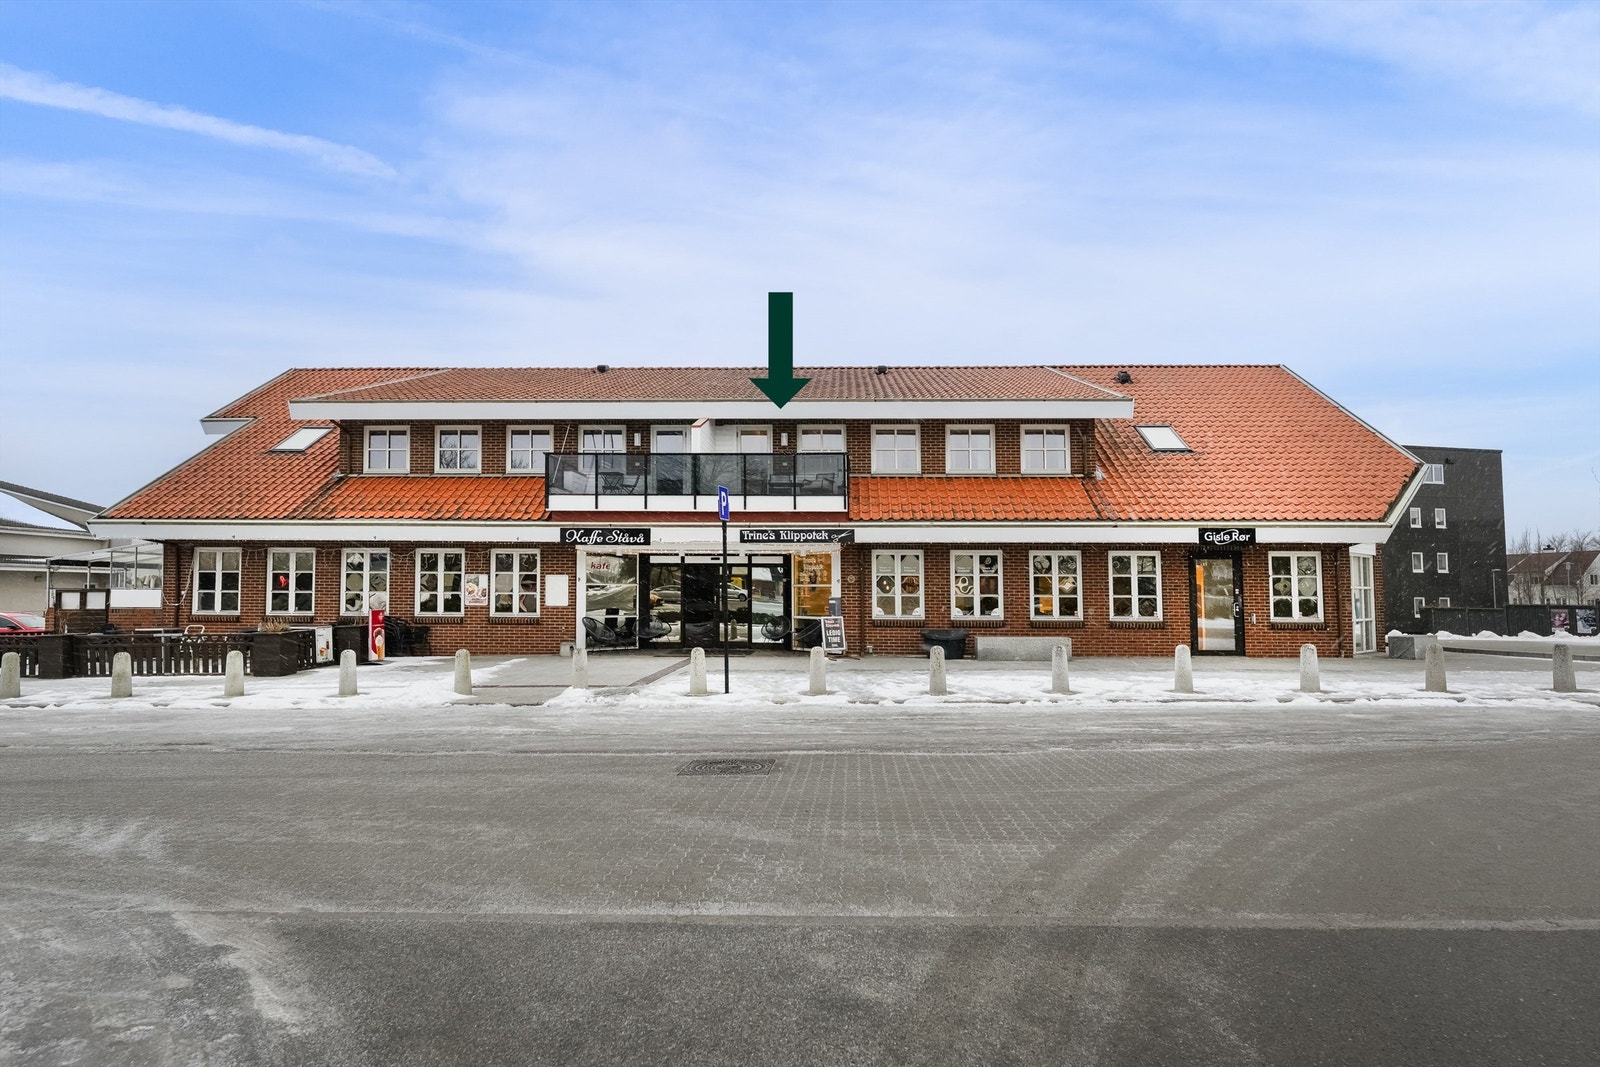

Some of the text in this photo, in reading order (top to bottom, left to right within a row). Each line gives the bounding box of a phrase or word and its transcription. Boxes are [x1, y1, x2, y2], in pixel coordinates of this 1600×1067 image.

[721, 491, 727, 516] P
[565, 529, 645, 545] Kaffe Ståvå
[742, 530, 829, 542] Trine's Klippotek
[1204, 531, 1251, 541] Gisle Rør
